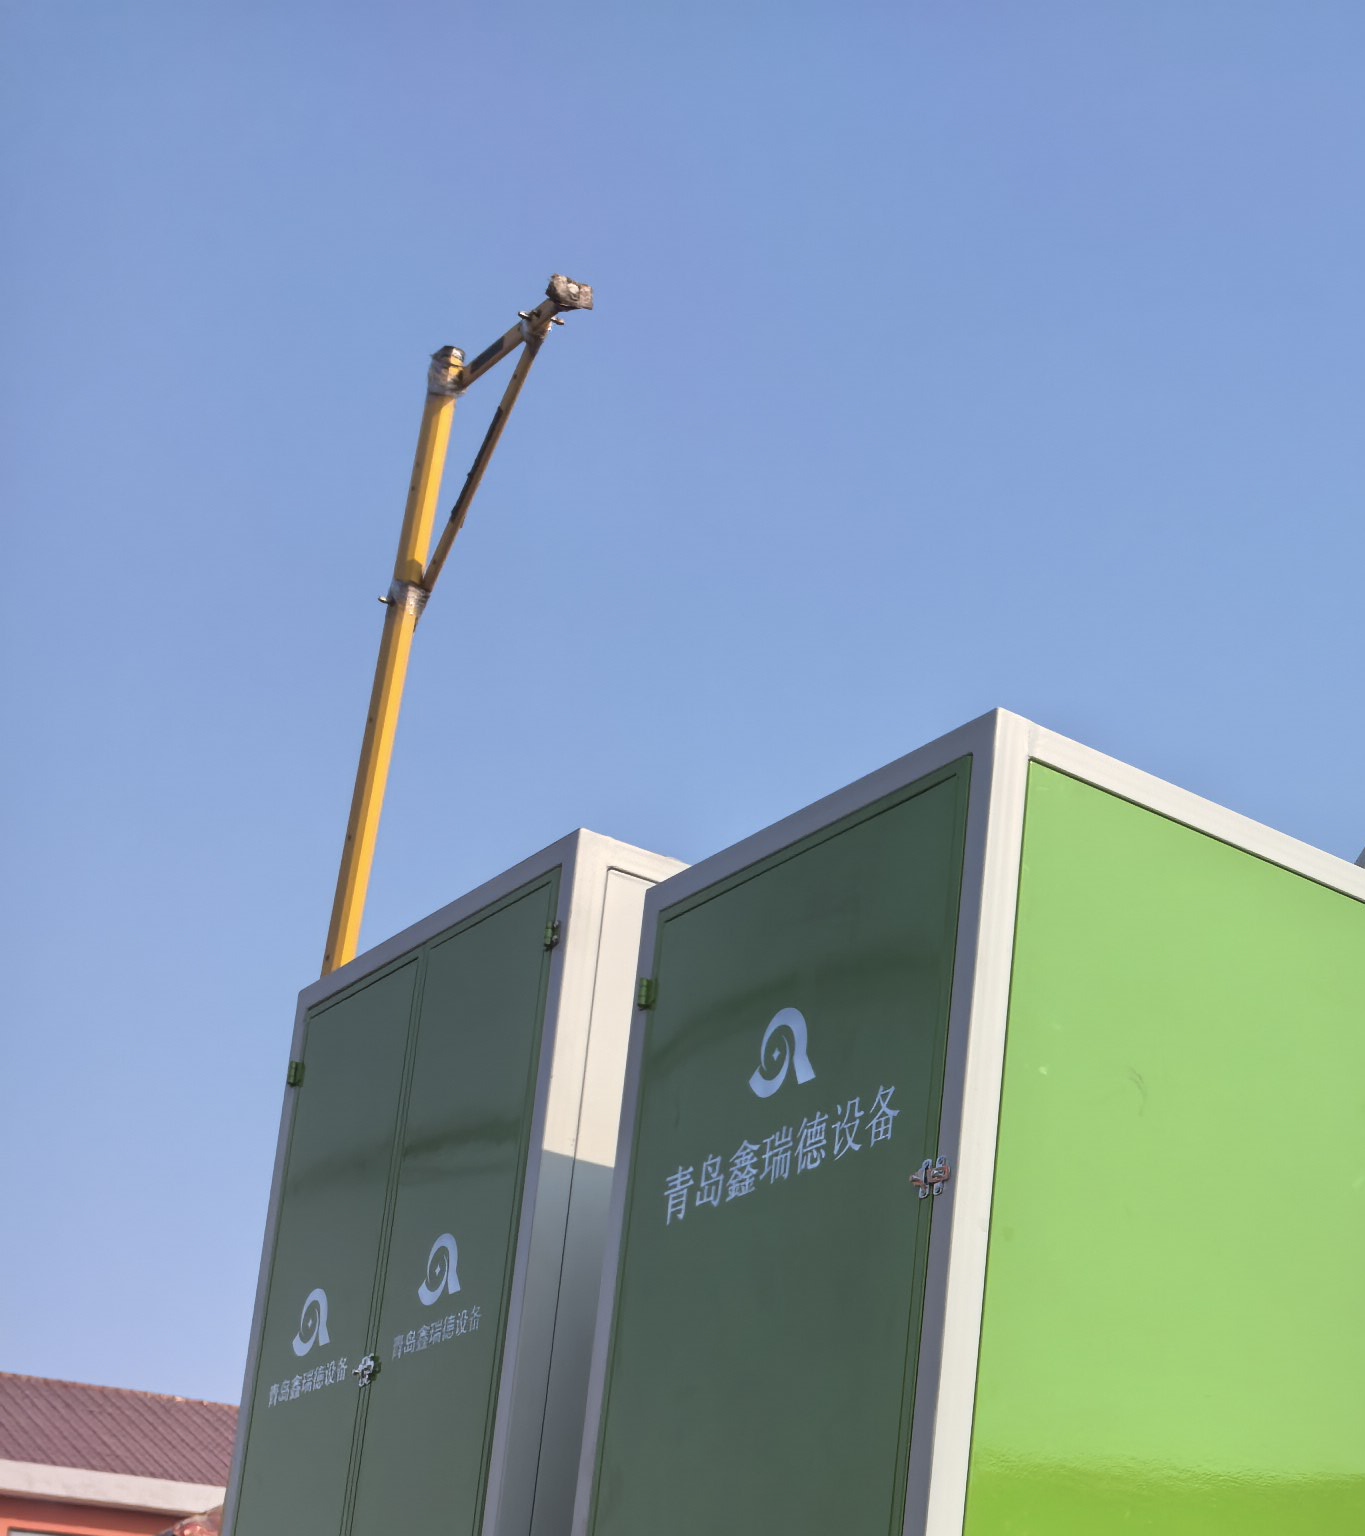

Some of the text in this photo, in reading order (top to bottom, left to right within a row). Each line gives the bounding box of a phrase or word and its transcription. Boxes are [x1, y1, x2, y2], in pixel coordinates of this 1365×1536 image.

[663, 1085, 900, 1226] 青岛鑫瑞德设备
